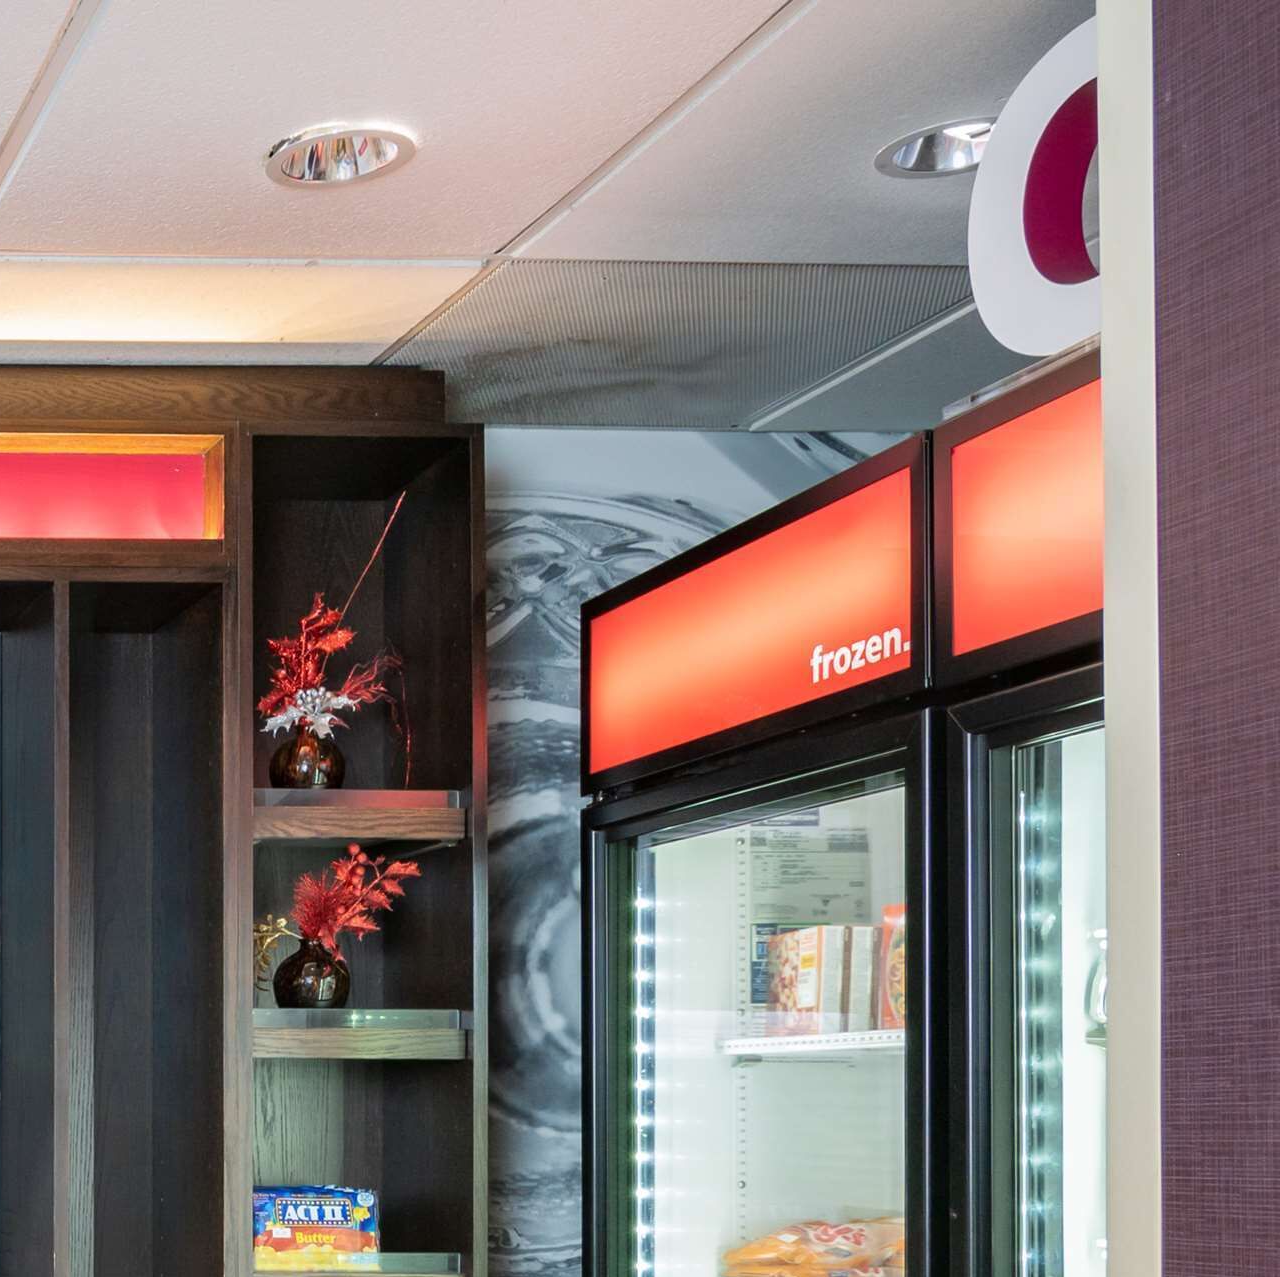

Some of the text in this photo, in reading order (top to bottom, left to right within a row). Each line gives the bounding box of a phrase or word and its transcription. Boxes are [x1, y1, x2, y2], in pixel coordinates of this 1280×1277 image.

[809, 626, 911, 684] frozen.
[284, 1205, 345, 1220] ACT II
[295, 1231, 336, 1244] Butter
